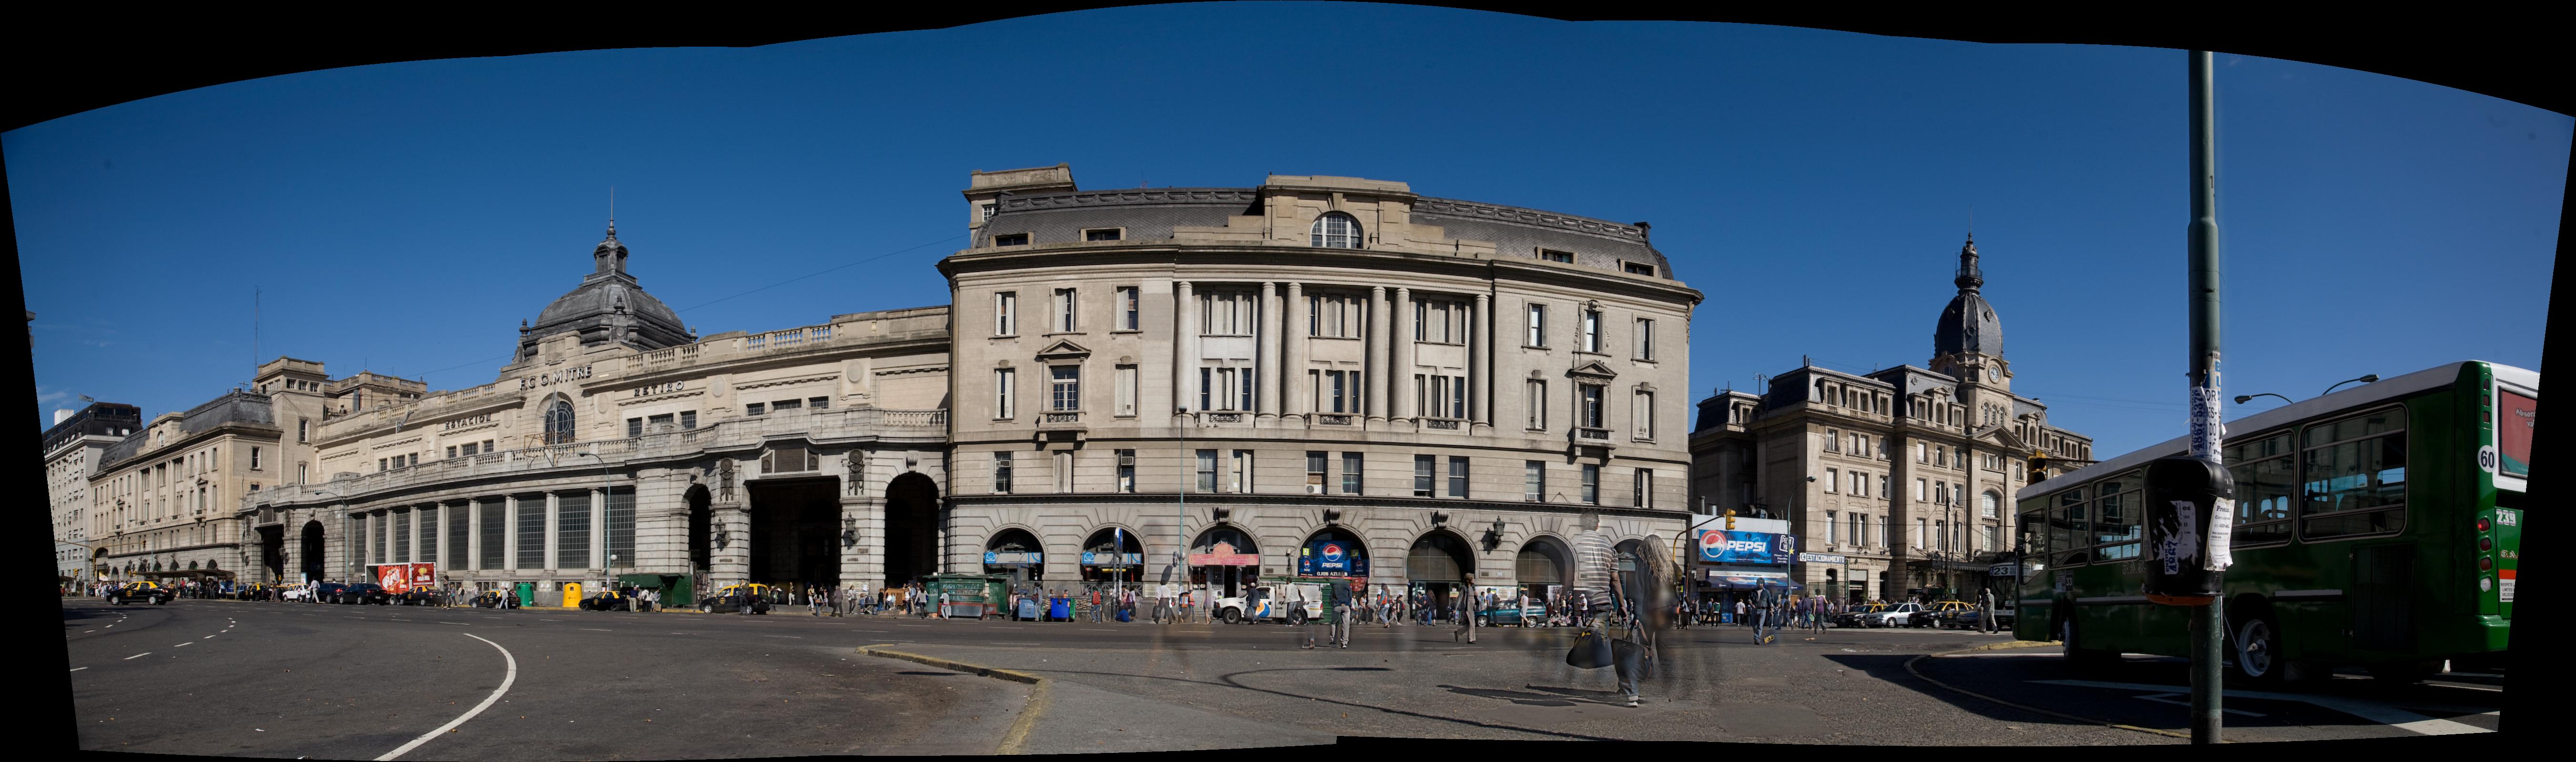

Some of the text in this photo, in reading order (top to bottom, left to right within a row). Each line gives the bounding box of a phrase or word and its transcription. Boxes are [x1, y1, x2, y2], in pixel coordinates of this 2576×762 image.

[634, 381, 684, 397] RETIRO
[445, 413, 491, 430] ESTACION
[2481, 451, 2495, 468] 60
[2496, 509, 2516, 526] 239
[1727, 541, 1767, 552] PEPSI
[1807, 554, 1845, 562] ESTACIONAMIENTO
[1994, 566, 2008, 575] 23
[2066, 577, 2072, 586] 33
